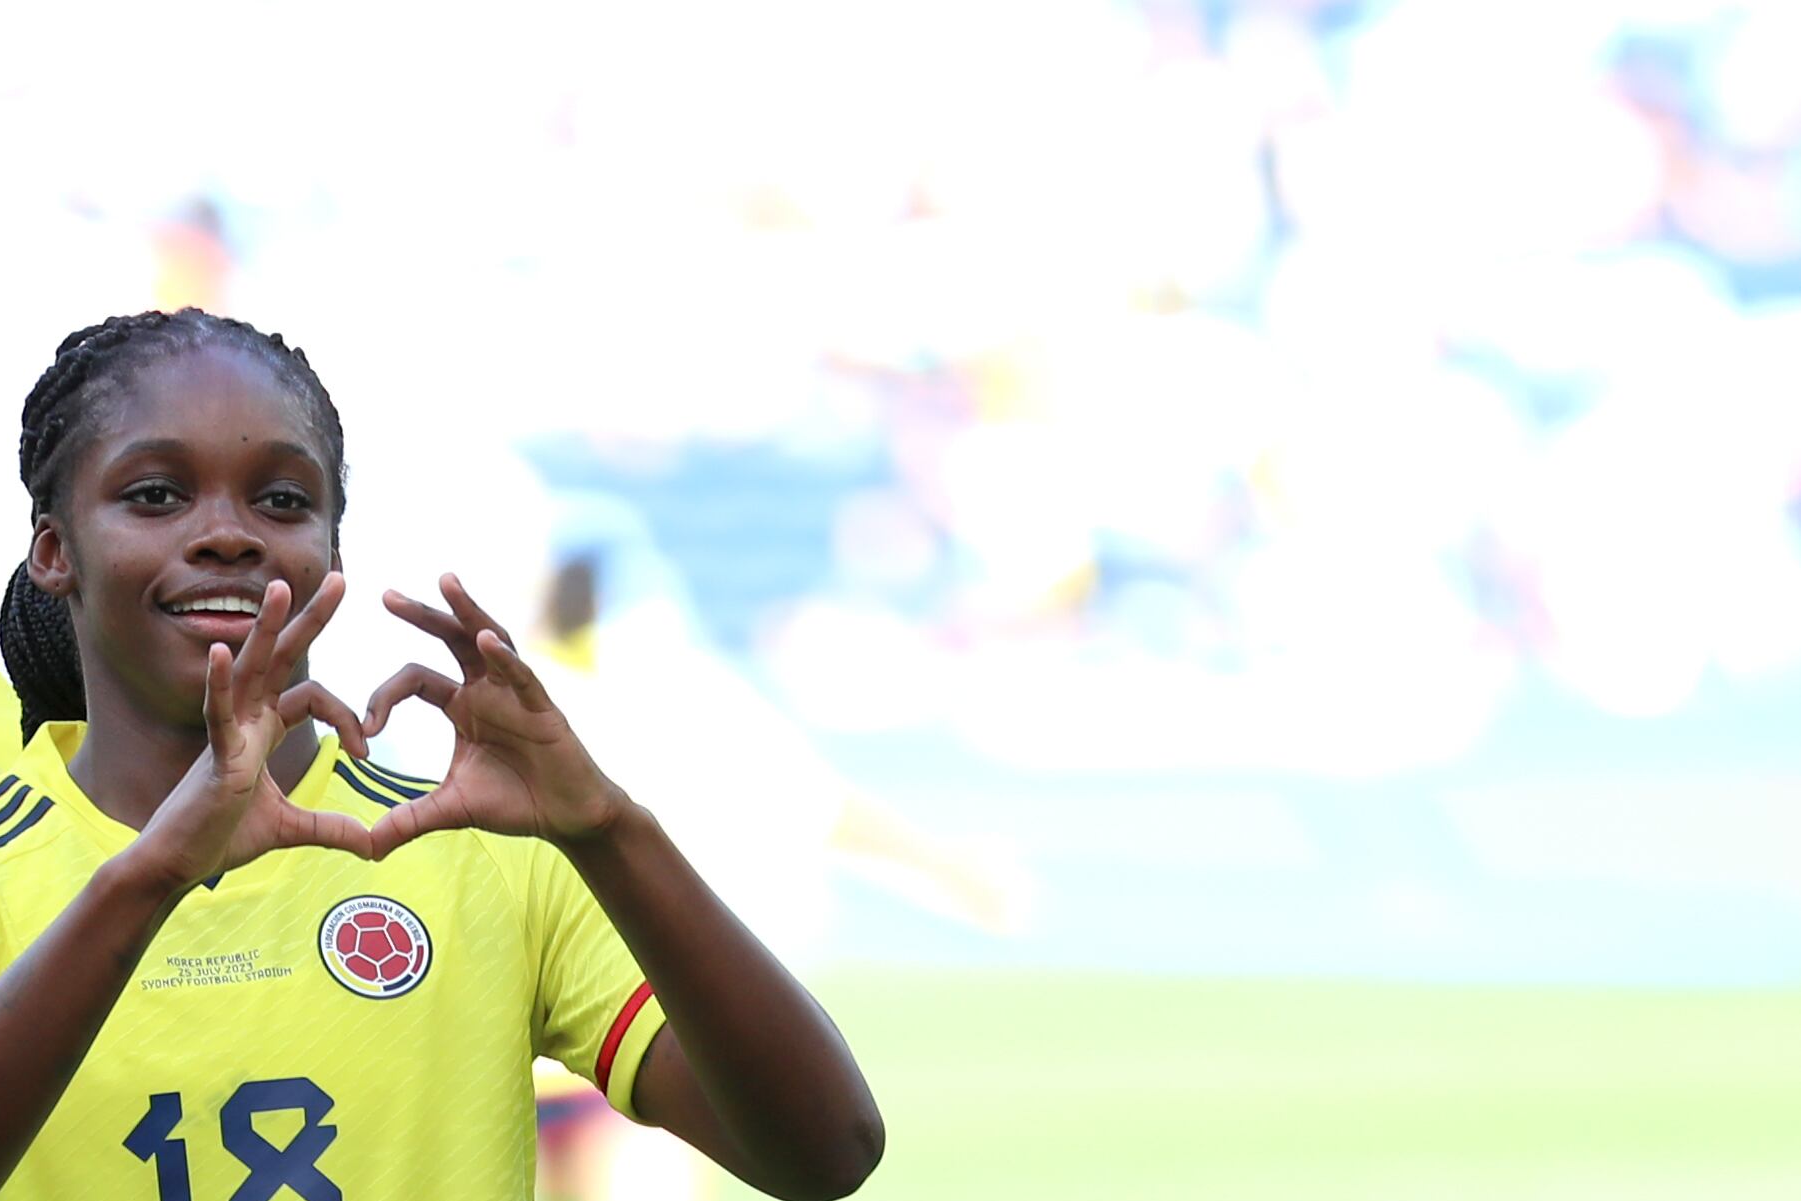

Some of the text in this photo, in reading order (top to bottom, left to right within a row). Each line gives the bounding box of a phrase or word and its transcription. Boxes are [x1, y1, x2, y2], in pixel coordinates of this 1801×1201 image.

[166, 949, 260, 968] KOREA REPUBLIC
[141, 967, 293, 990] SYDNEY FOOTBALL STADIUM
[178, 962, 254, 977] 25 JULY 2023
